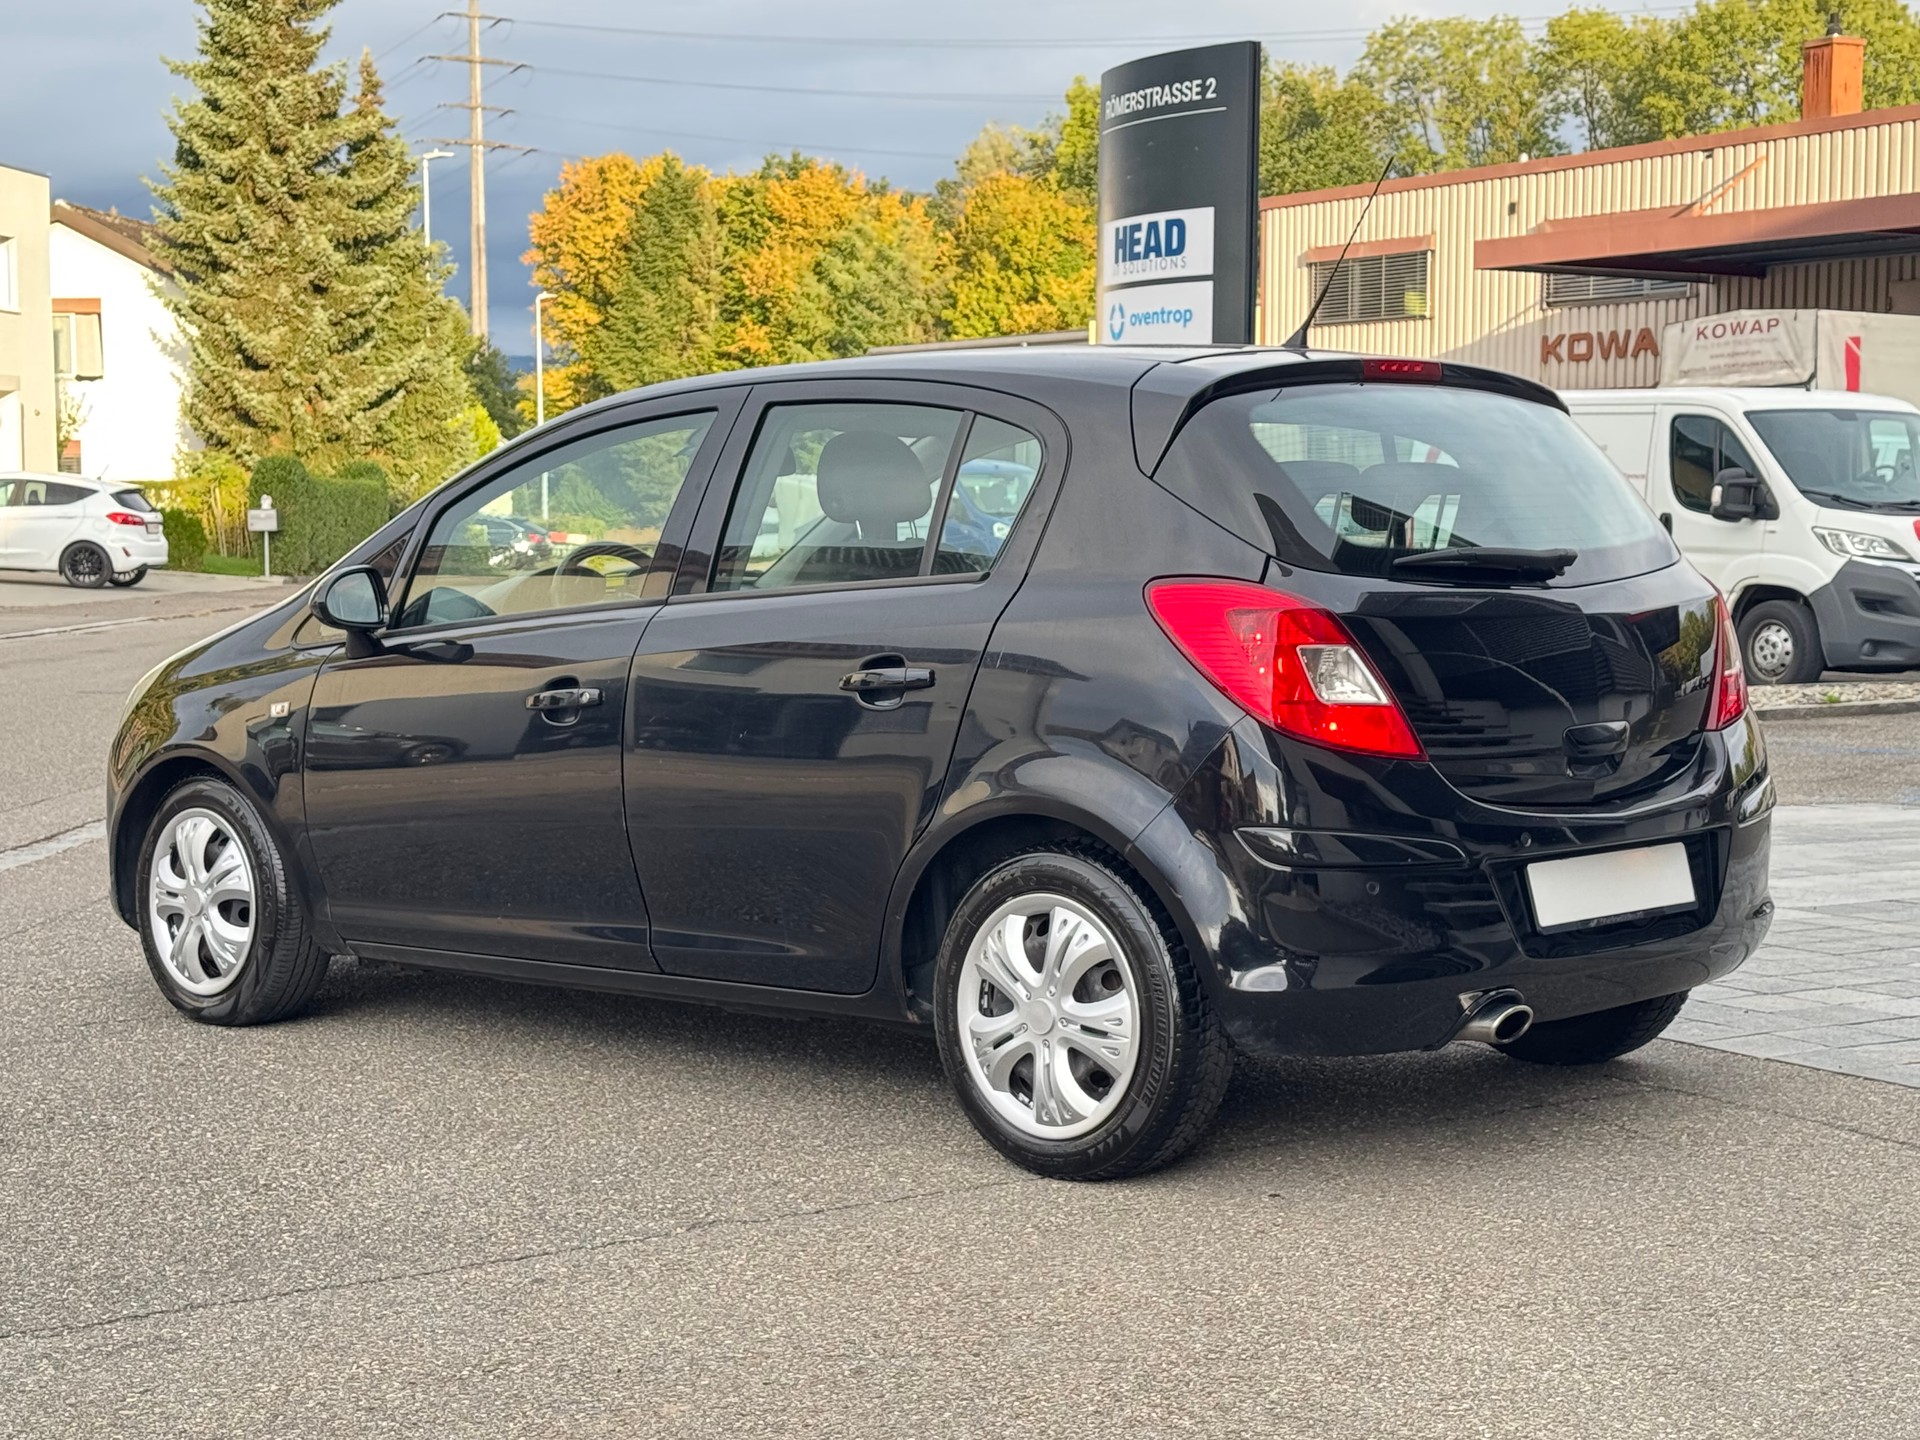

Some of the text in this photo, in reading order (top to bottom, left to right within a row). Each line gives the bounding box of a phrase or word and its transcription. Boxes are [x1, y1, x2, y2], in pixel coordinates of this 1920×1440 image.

[1105, 77, 1217, 120] RÖMERSTRASSE 2
[1114, 218, 1187, 265] HEAD
[1123, 256, 1188, 276] SOLUTIONS
[1129, 307, 1194, 329] oventrop
[1696, 317, 1780, 341] KOWAP
[1541, 327, 1660, 364] KOWA
